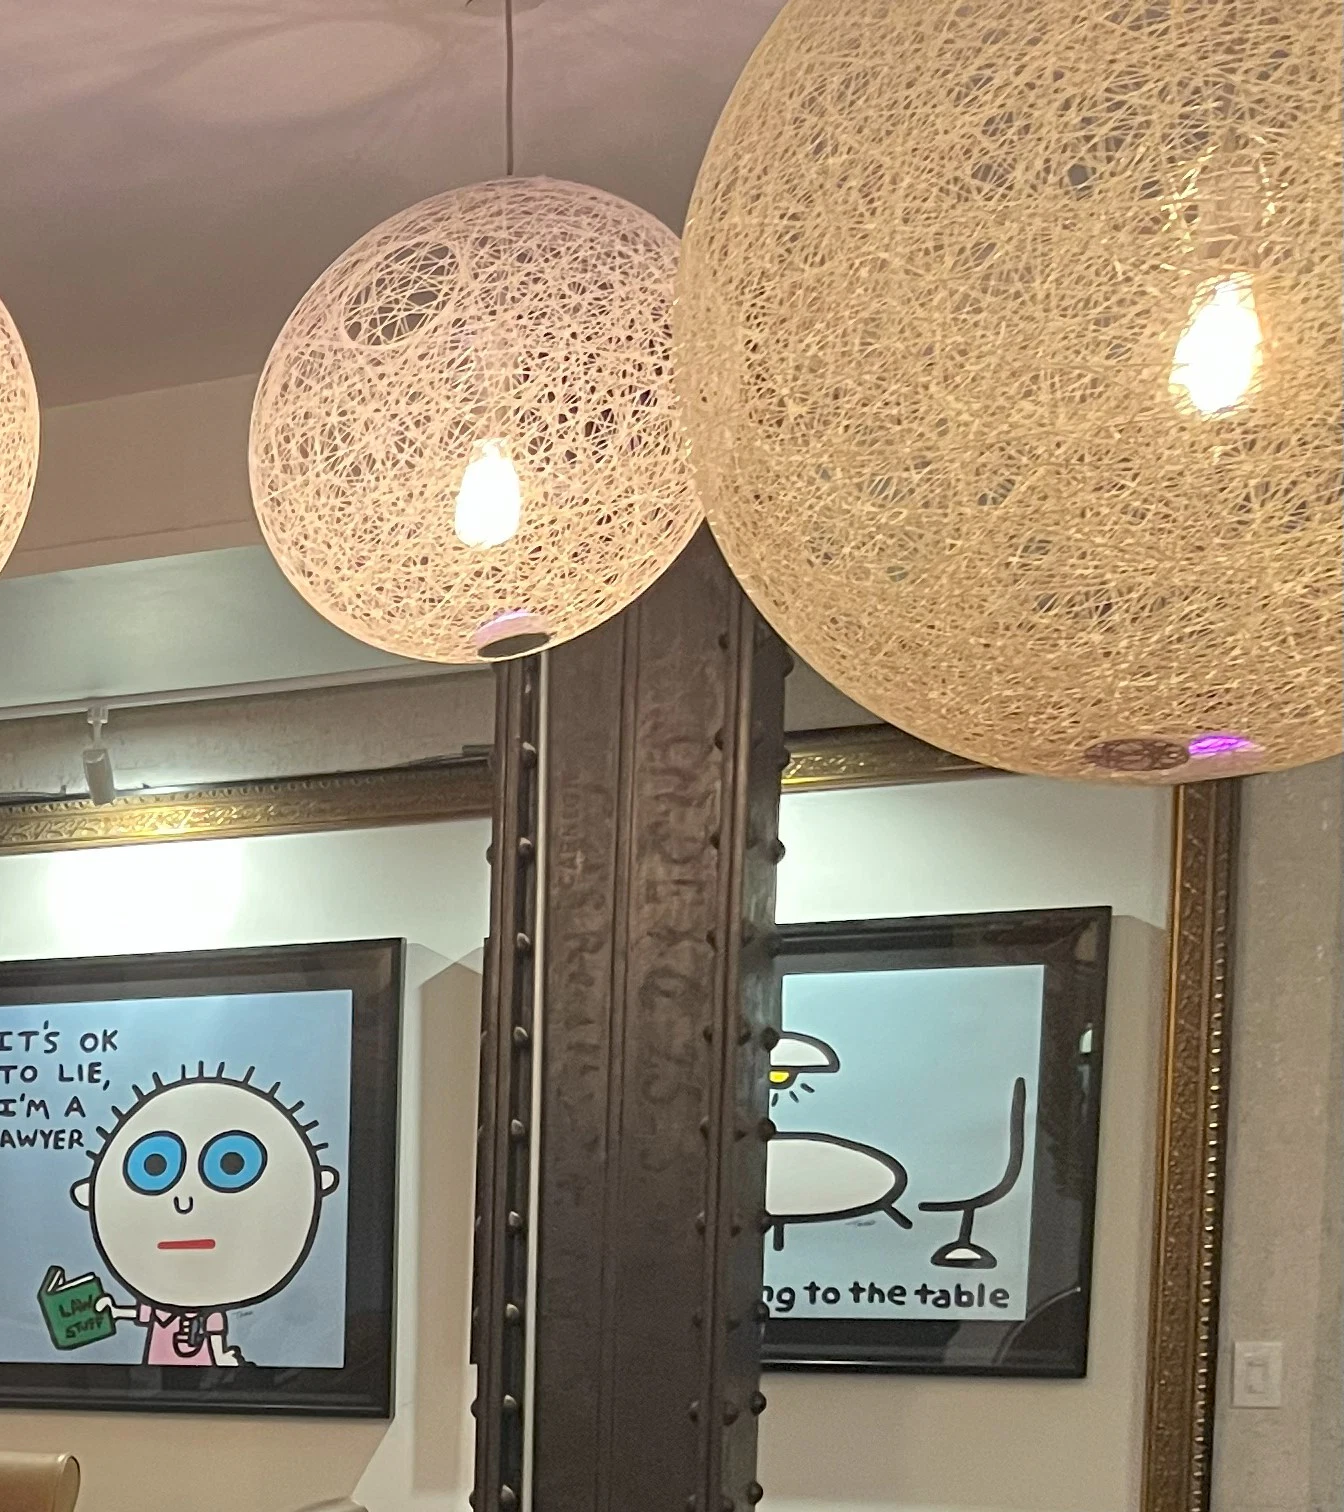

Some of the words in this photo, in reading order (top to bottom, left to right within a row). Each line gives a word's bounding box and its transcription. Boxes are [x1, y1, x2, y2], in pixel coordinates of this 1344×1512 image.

[79, 1029, 119, 1053] OK
[58, 1062, 110, 1091] LIE,
[64, 1095, 86, 1118] A
[58, 1294, 93, 1318] LAW
[762, 1286, 797, 1313] ng
[803, 1281, 841, 1305] to
[848, 1281, 907, 1306] the
[914, 1283, 1010, 1309] table
